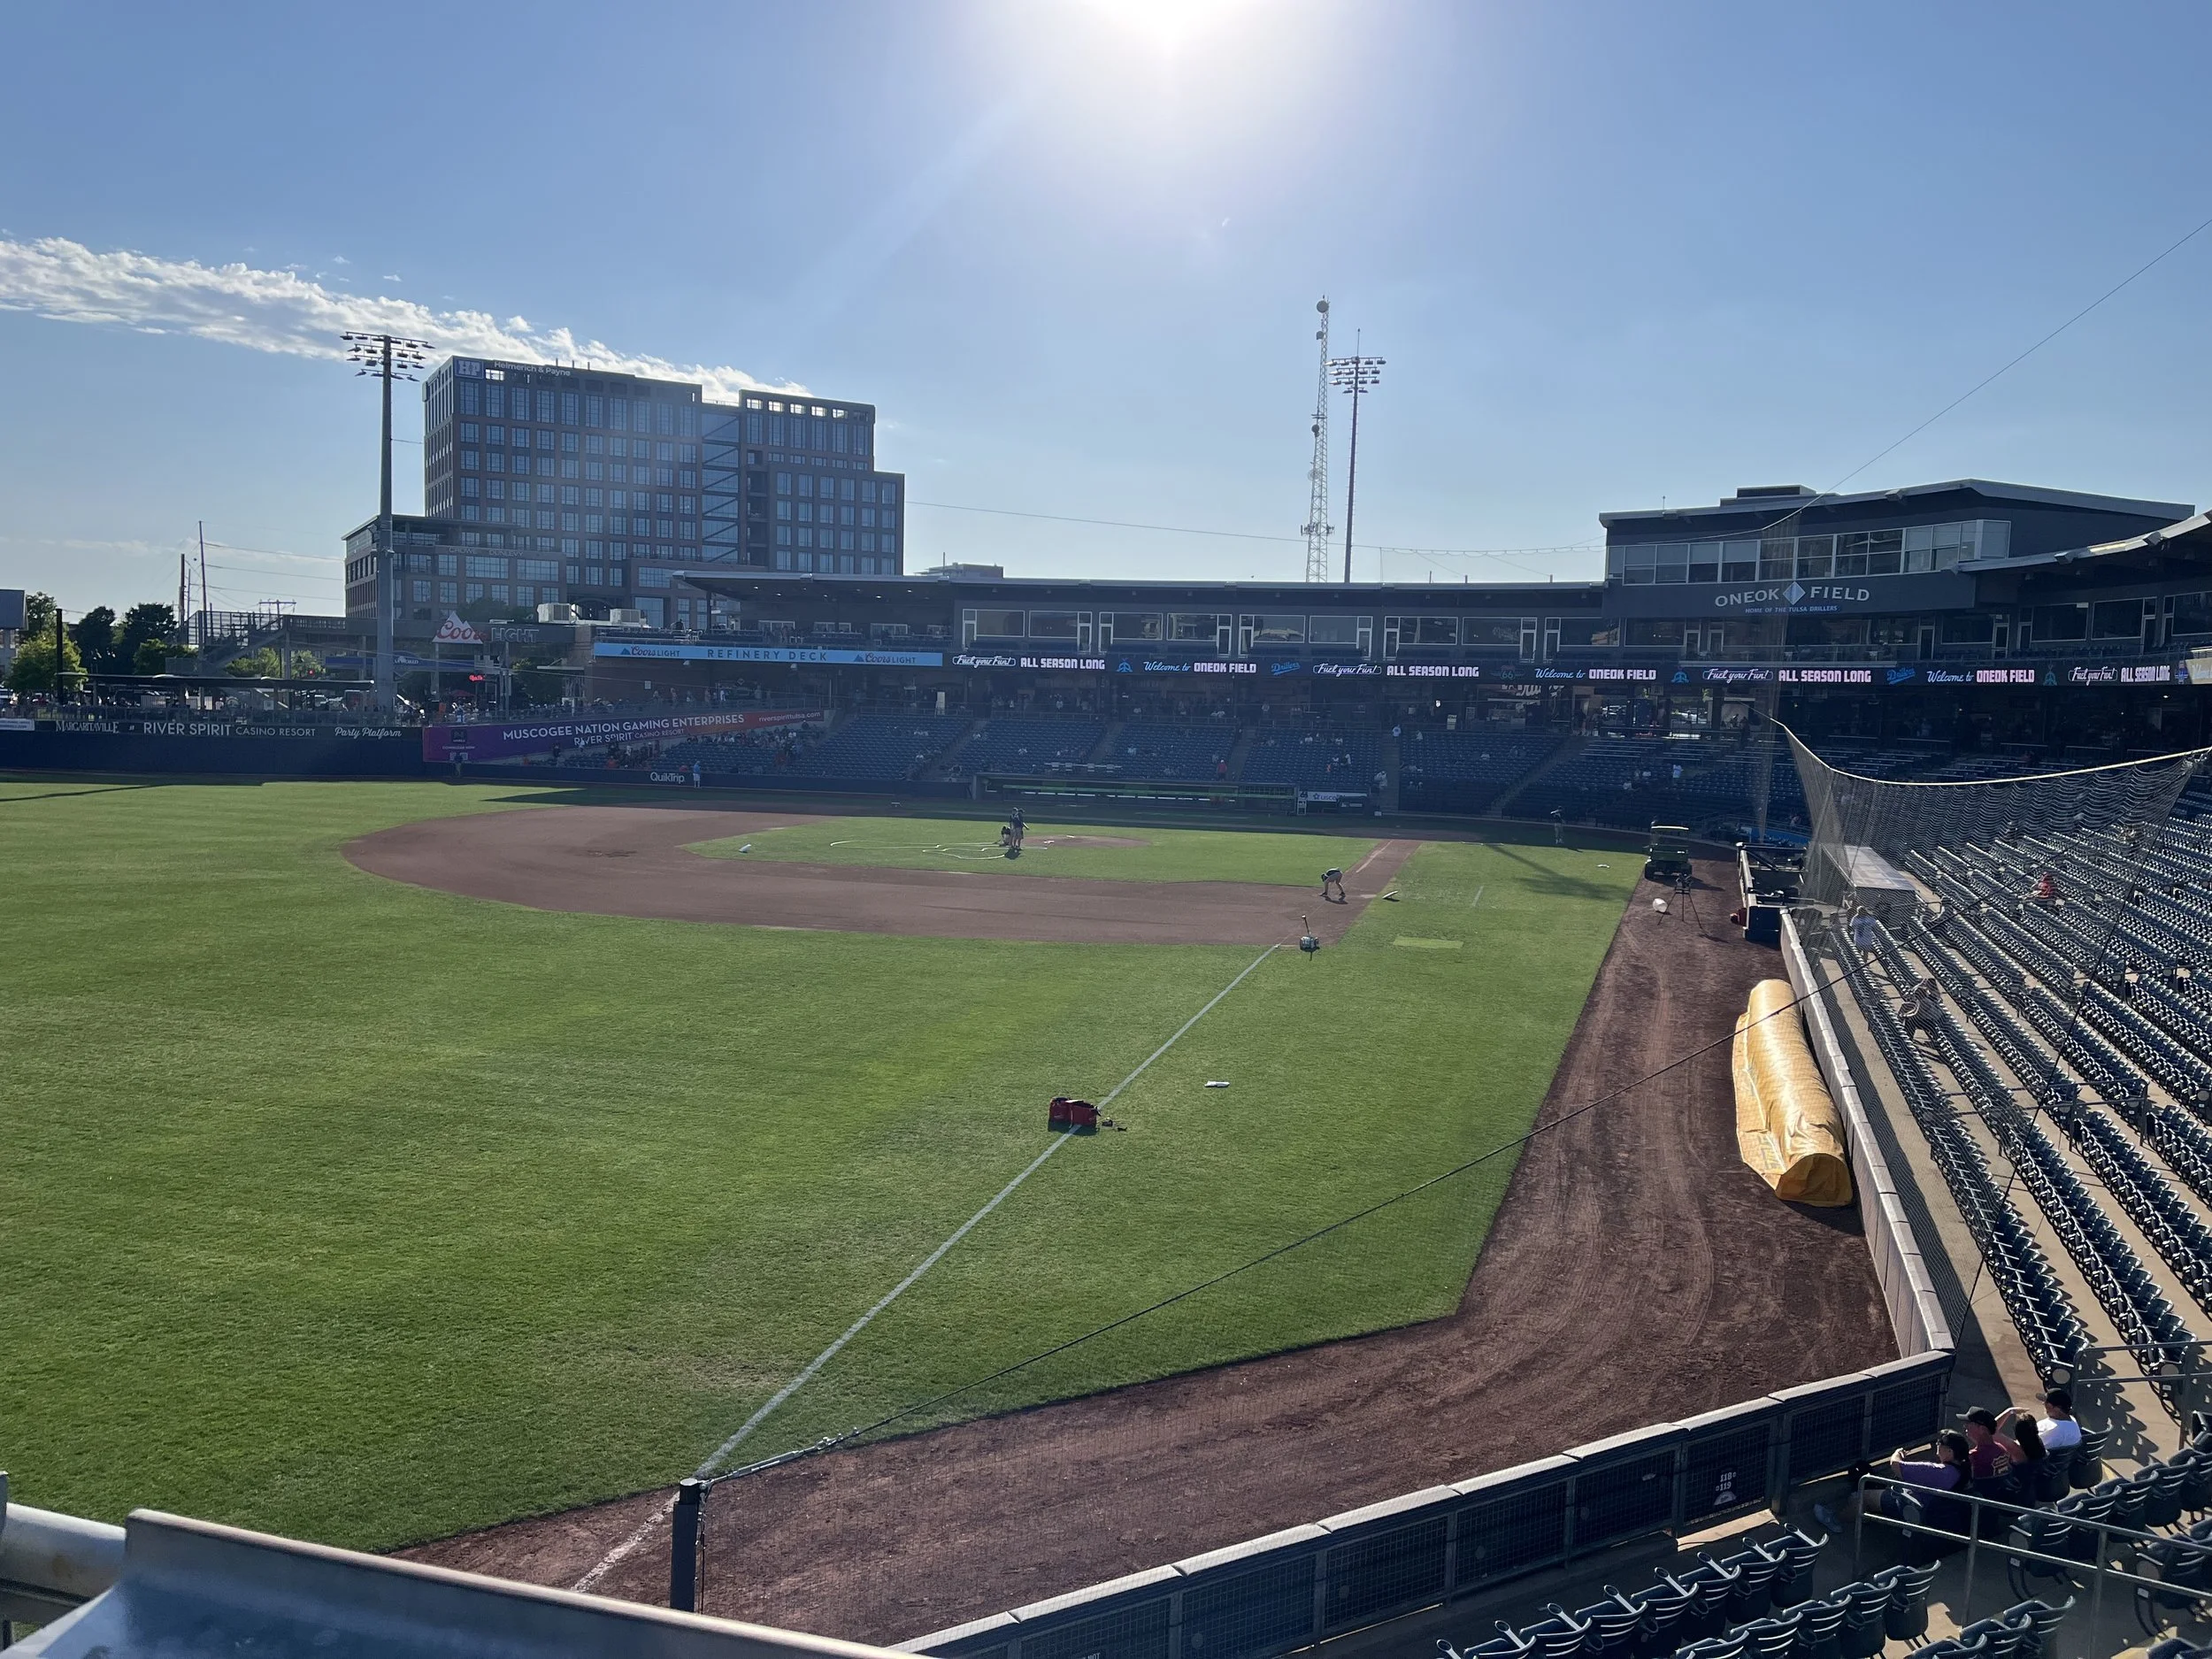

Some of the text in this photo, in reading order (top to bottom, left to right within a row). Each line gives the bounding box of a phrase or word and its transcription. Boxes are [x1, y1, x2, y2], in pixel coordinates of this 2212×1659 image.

[494, 361, 536, 373] Helmerich
[546, 367, 571, 377] Payne
[1714, 586, 1870, 607] ONEOK FIELD
[631, 645, 656, 657] Coors
[708, 649, 827, 661] REFINERY DECK
[864, 653, 891, 664] Coors
[956, 655, 975, 664] Fuel
[1020, 657, 1038, 668] ALL
[1040, 657, 1078, 669] SEASON
[1079, 659, 1105, 670] LONG
[1143, 661, 1256, 673] Welcome to ONEOK FIELD
[1317, 663, 1479, 678] Fuel your Fun! ALL SEASON LONG
[2071, 666, 2087, 681] Fuel
[2099, 665, 2116, 681] Fun!
[2121, 667, 2134, 682] ALL
[2134, 666, 2156, 682] SEASON
[2156, 665, 2170, 681] LONG
[1534, 668, 1656, 680] Welcome to ONEOK FIELD
[1707, 668, 1871, 683] Fuel your Fun! ALL SEASON LONG
[1926, 669, 2035, 683] Welcome to ONEOK FIELD
[758, 710, 821, 723] riverspirittulsa.com
[143, 722, 185, 735] RIVER
[189, 723, 232, 736] SPIRIT
[235, 726, 276, 736] CASINO
[280, 728, 316, 737] RESORT
[334, 726, 403, 740] Party Platform
[503, 714, 745, 741] MUSCOGEE NATION GAMING ENTERPRISES
[605, 732, 633, 743] SPIRIT
[634, 730, 660, 739] CASINO
[650, 772, 685, 784] QuikTrip
[1719, 1471, 1732, 1483] 118
[1719, 1481, 1732, 1491] 119
